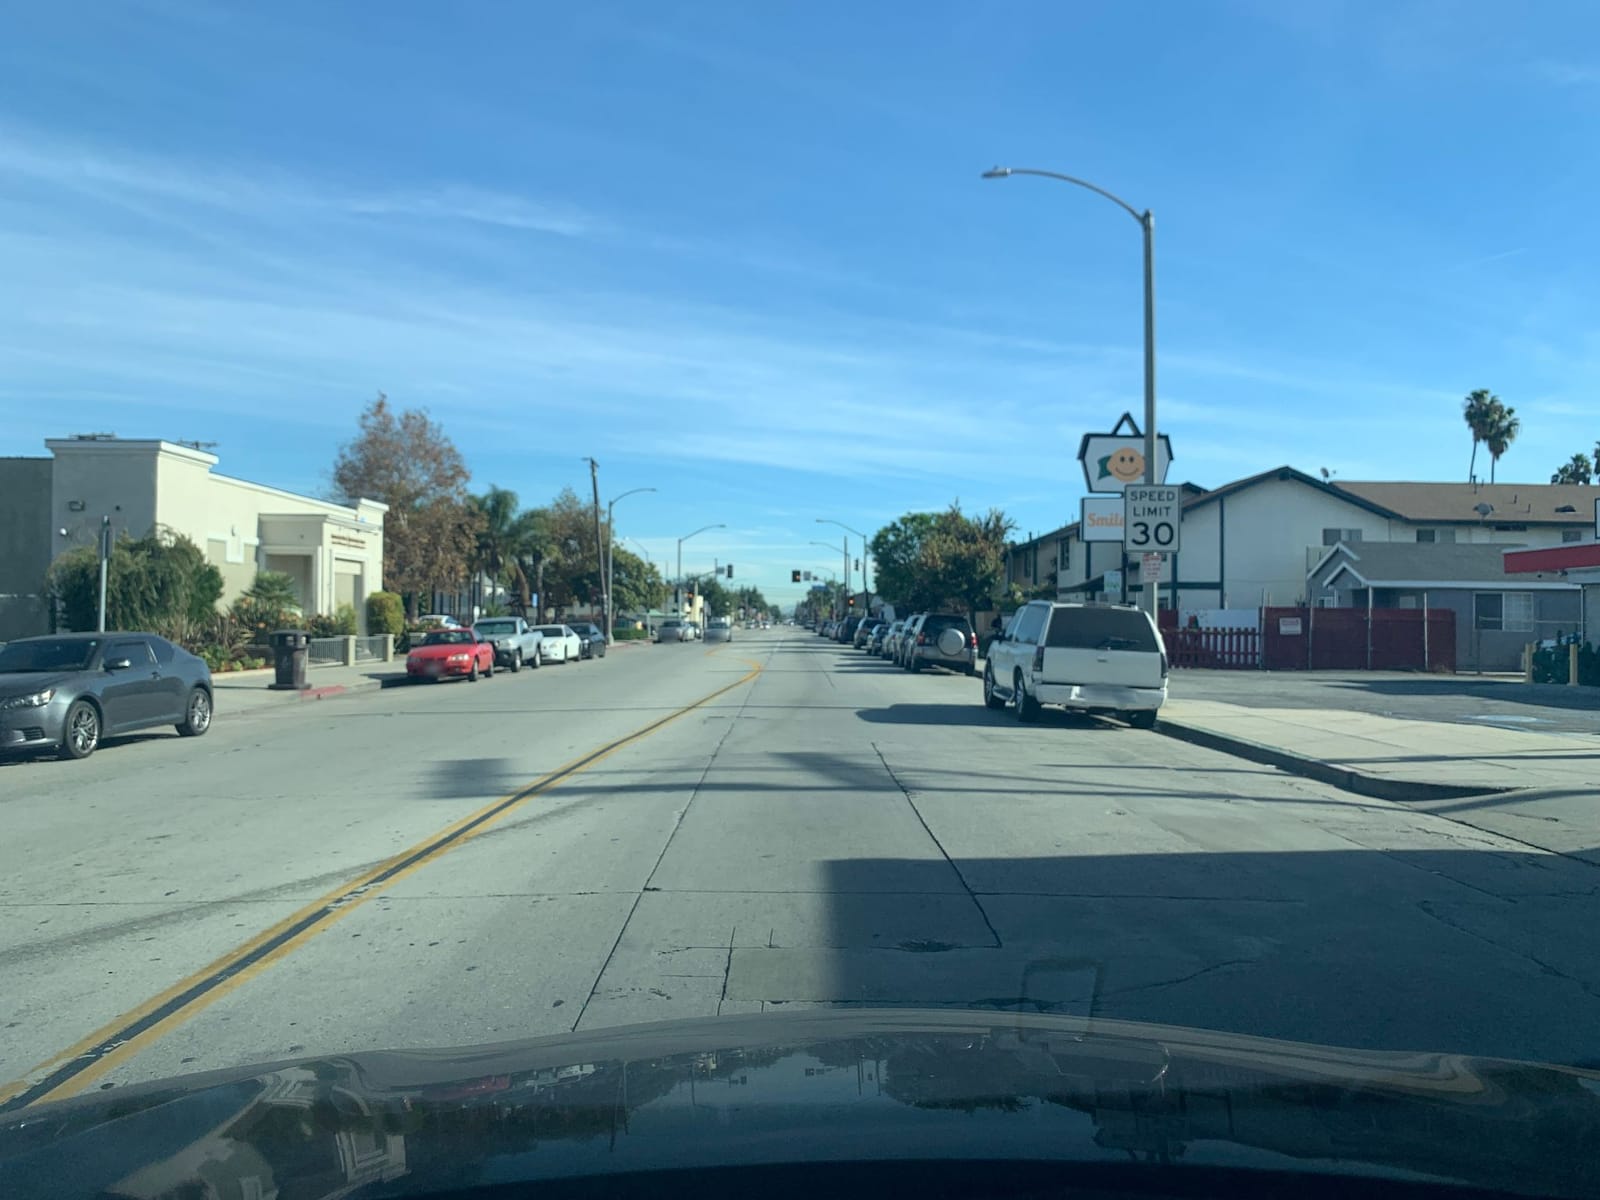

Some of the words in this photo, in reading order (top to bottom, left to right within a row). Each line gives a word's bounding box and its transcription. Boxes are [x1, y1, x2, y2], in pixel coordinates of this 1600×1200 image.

[1130, 490, 1175, 501] SPEED
[1133, 506, 1171, 517] LIMIT
[1131, 521, 1174, 546] 30
